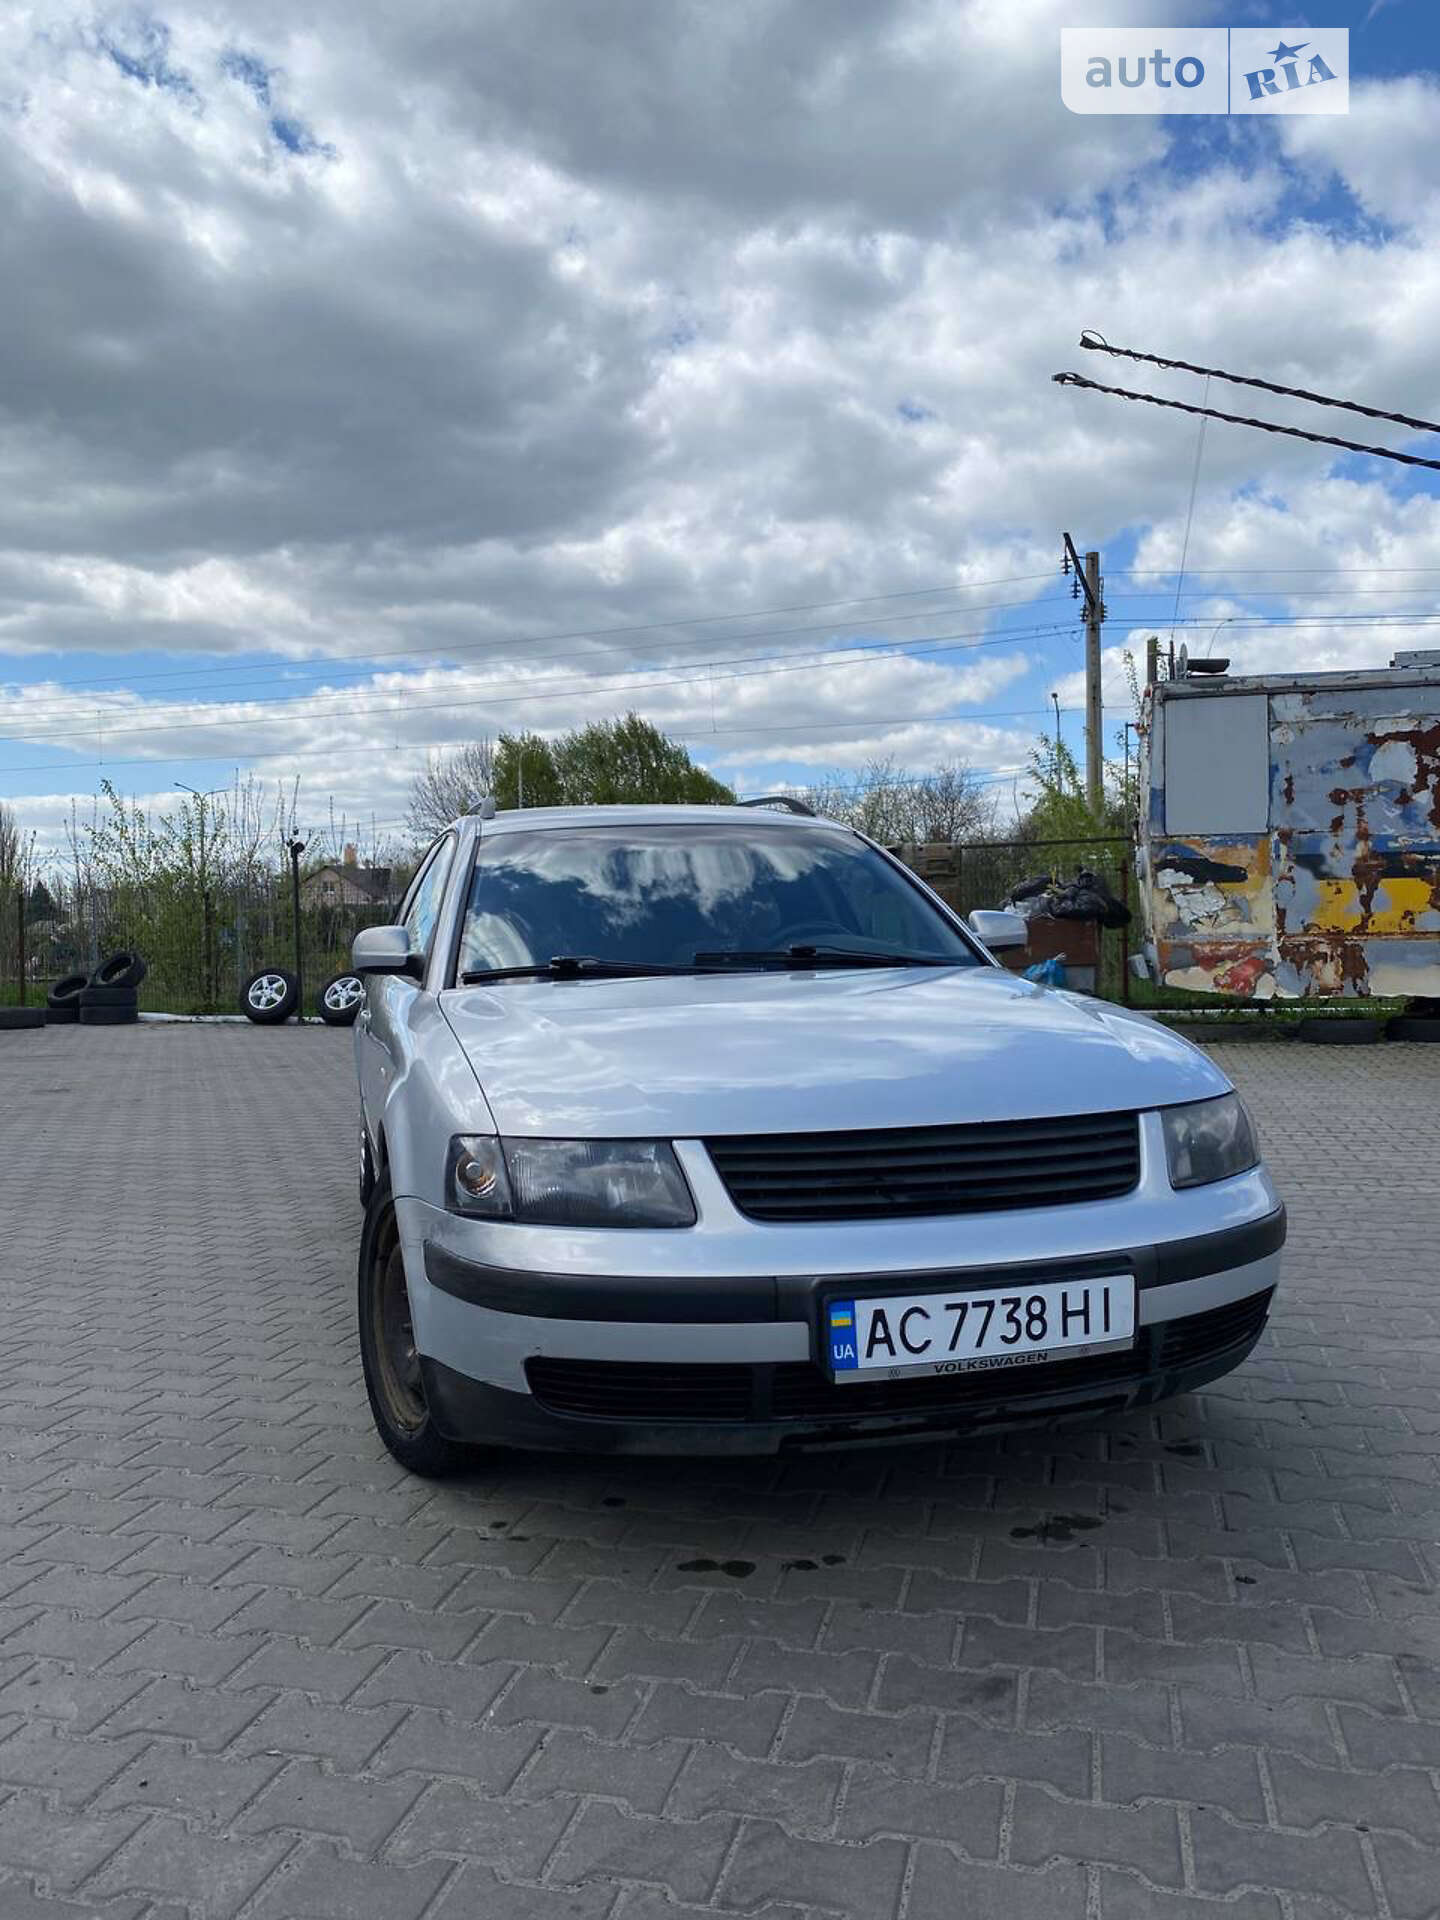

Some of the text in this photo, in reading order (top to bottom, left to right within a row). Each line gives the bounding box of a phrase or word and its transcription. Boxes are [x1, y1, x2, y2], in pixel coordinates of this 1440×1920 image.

[865, 1286, 1110, 1358] AC 7738 HI
[833, 1344, 854, 1359] UA
[933, 1352, 1048, 1374] VOLKSWAGEN
